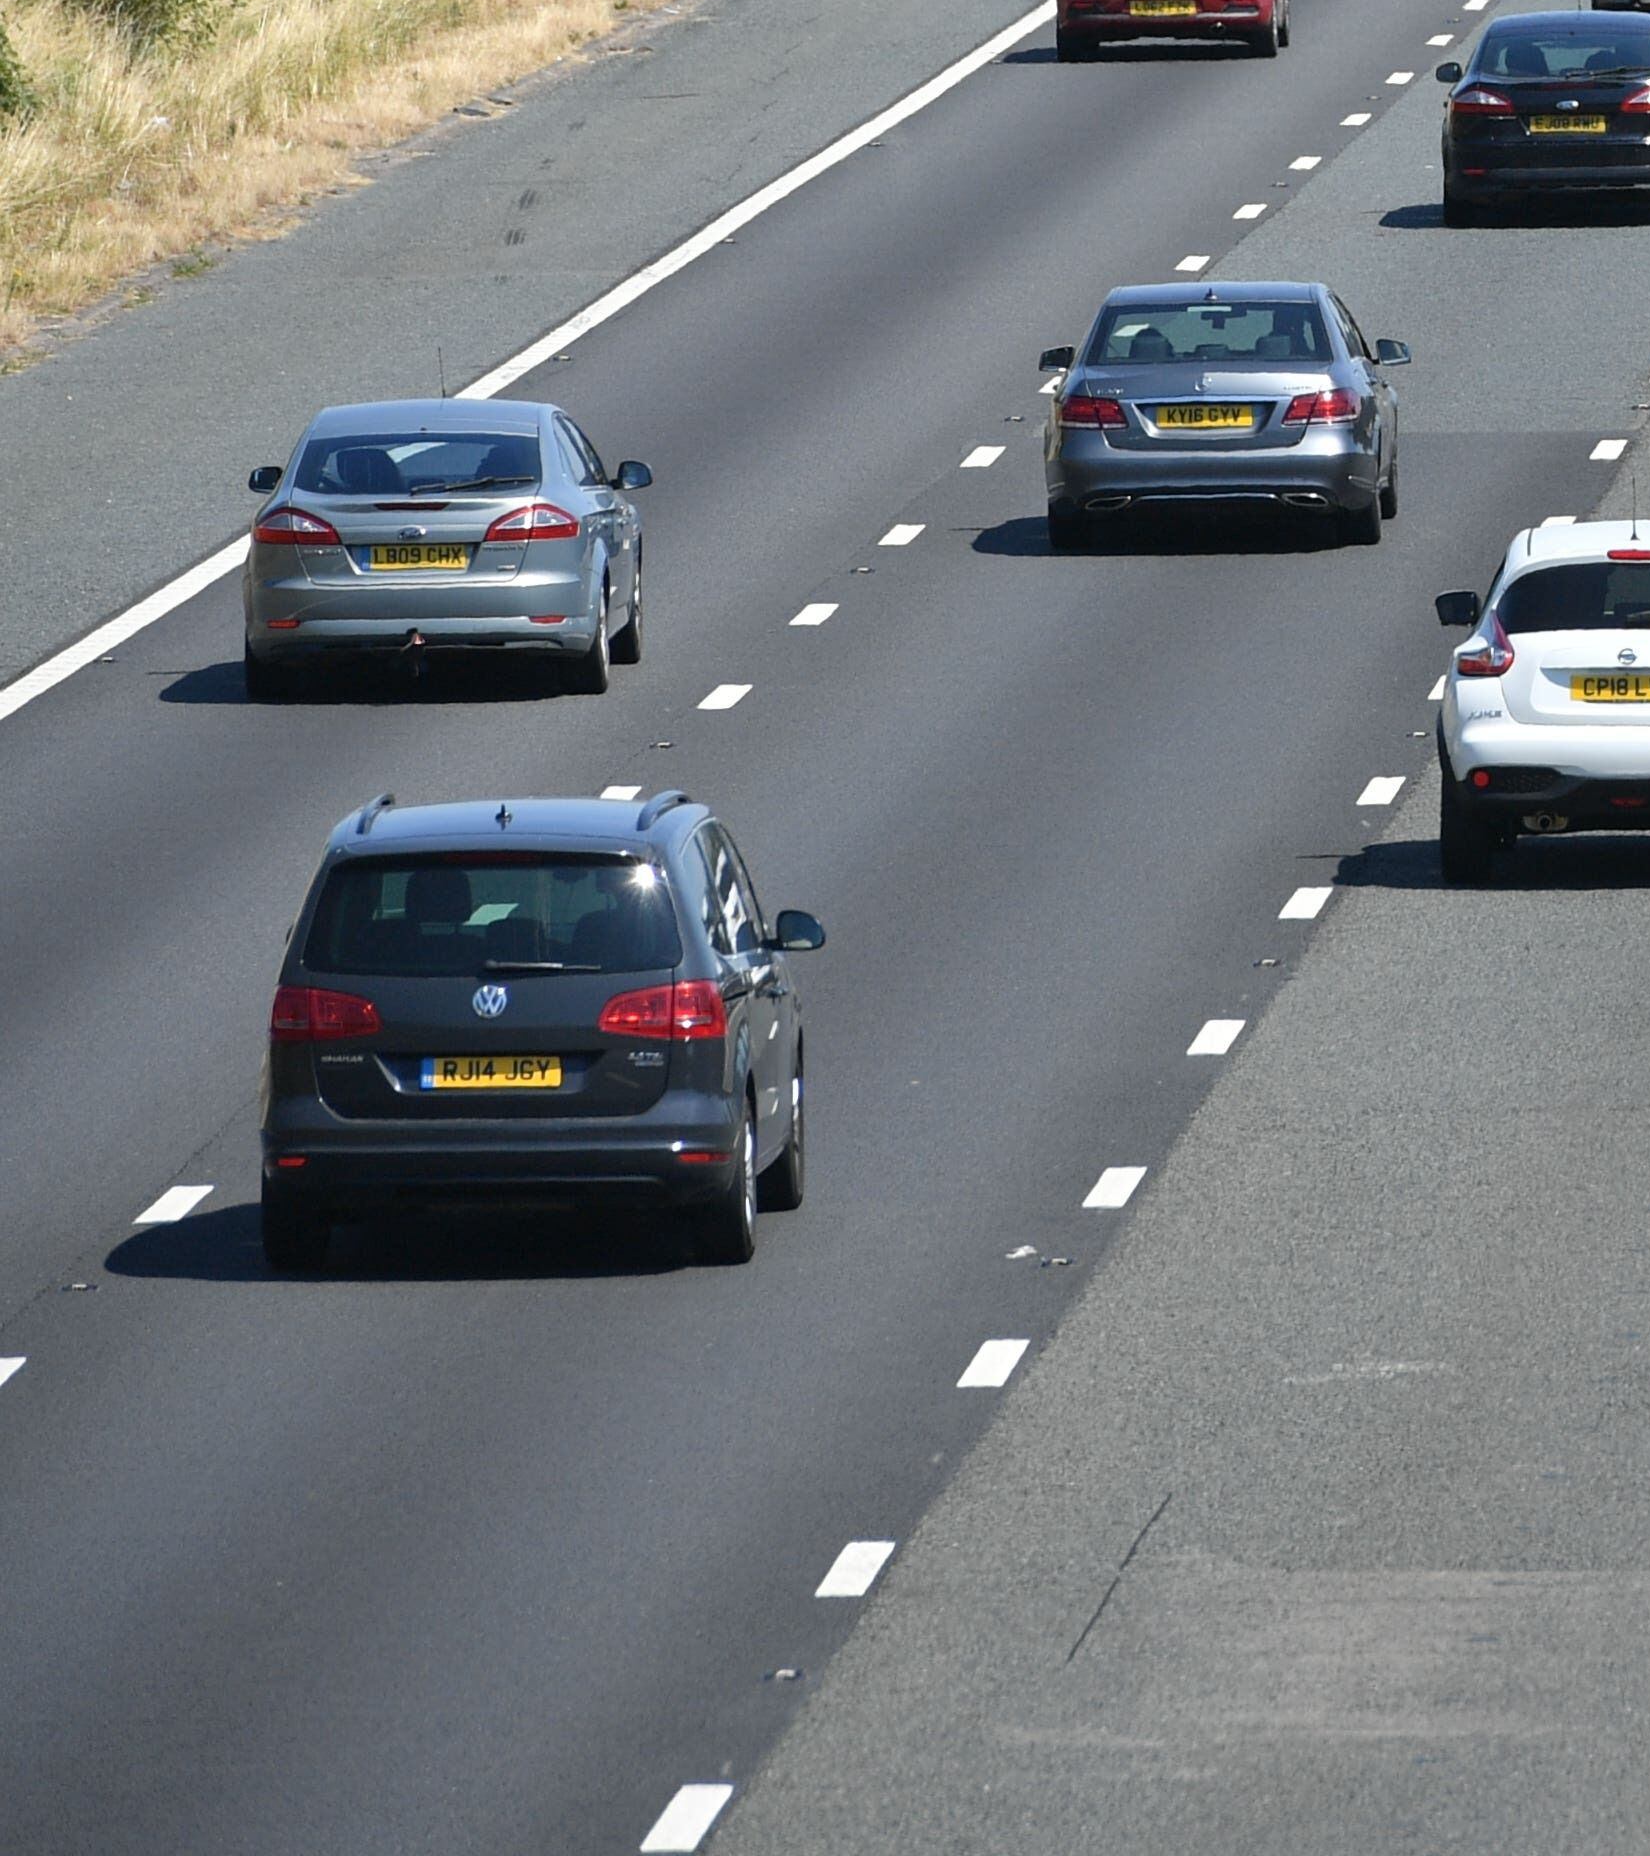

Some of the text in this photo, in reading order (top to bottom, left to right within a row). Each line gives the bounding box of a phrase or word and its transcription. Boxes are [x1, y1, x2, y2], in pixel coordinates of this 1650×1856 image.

[1167, 406, 1240, 423] KY16 GYV
[373, 547, 421, 564] LB09
[427, 547, 462, 564] CHX
[1583, 678, 1628, 697] CP18
[443, 1060, 550, 1081] RJ14 JGY
